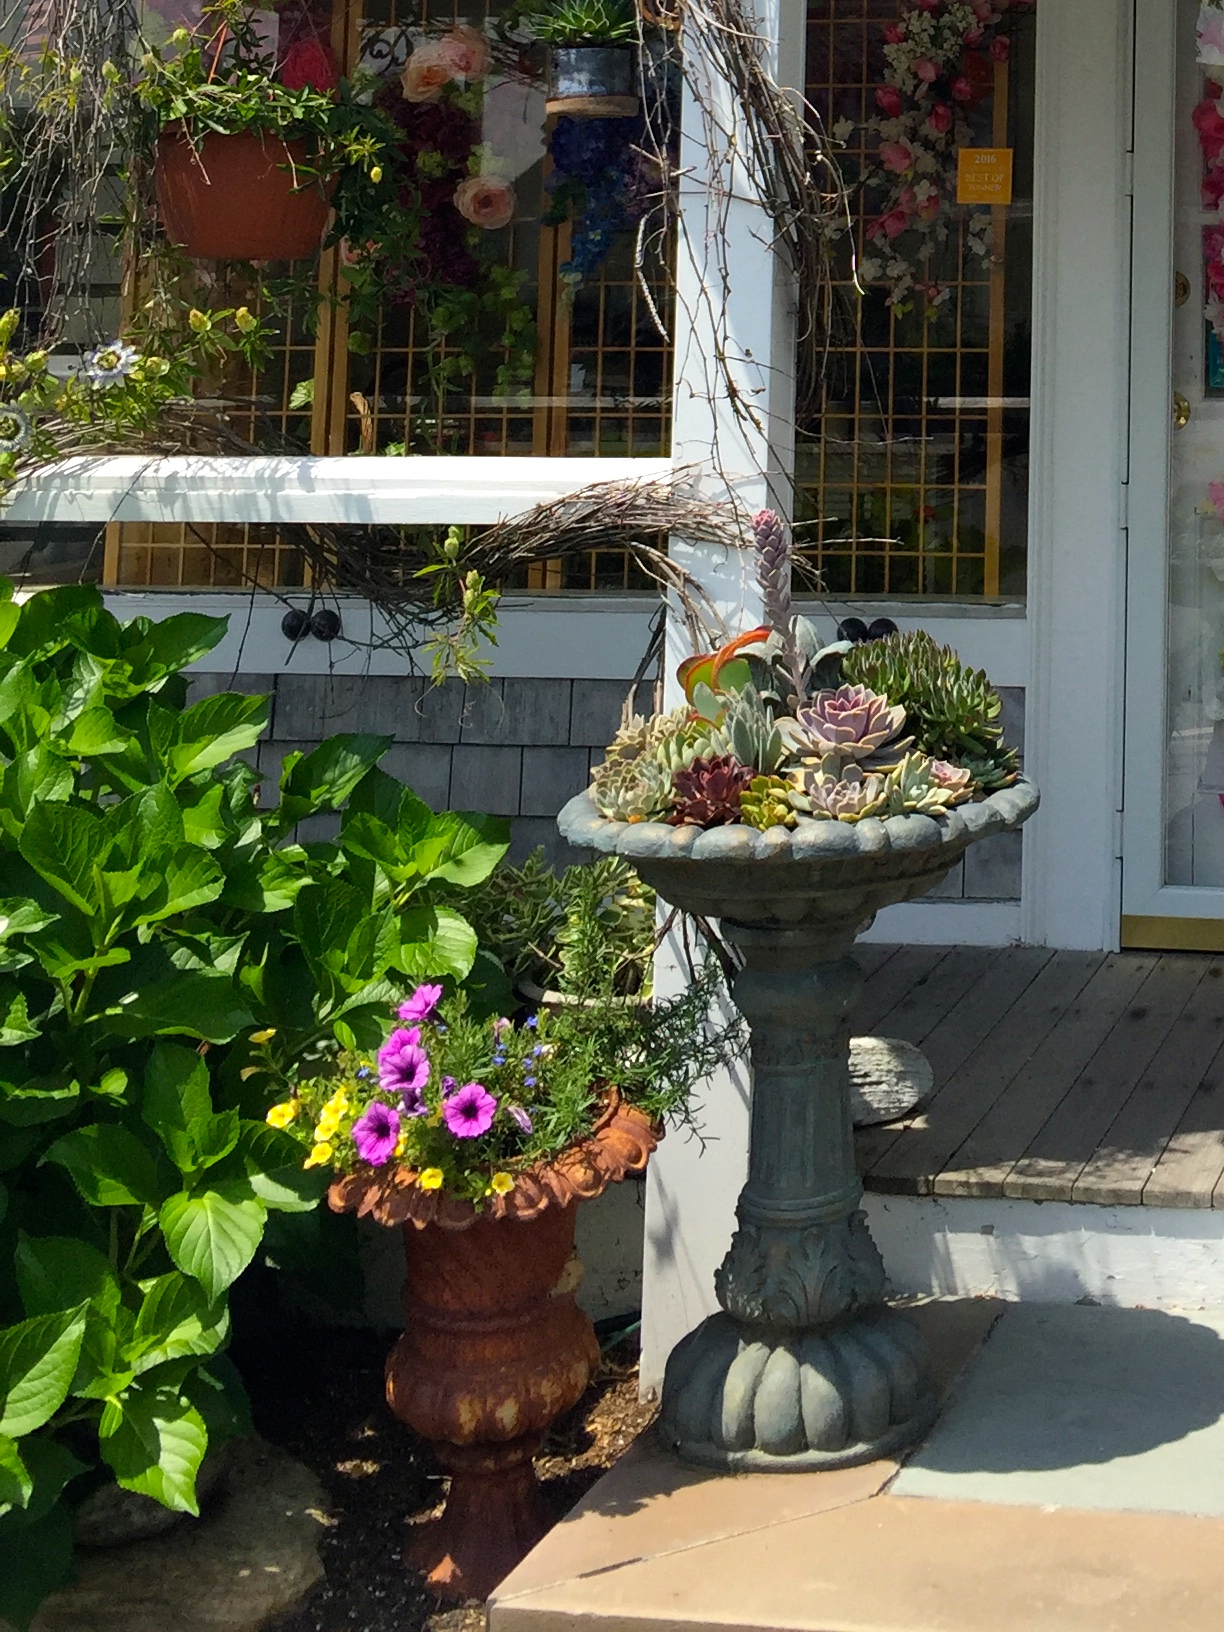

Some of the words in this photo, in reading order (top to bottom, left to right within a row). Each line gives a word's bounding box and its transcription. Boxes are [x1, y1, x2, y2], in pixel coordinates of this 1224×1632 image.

[974, 154, 997, 164] 2016
[965, 173, 989, 183] BEST
[991, 173, 1004, 183] OF
